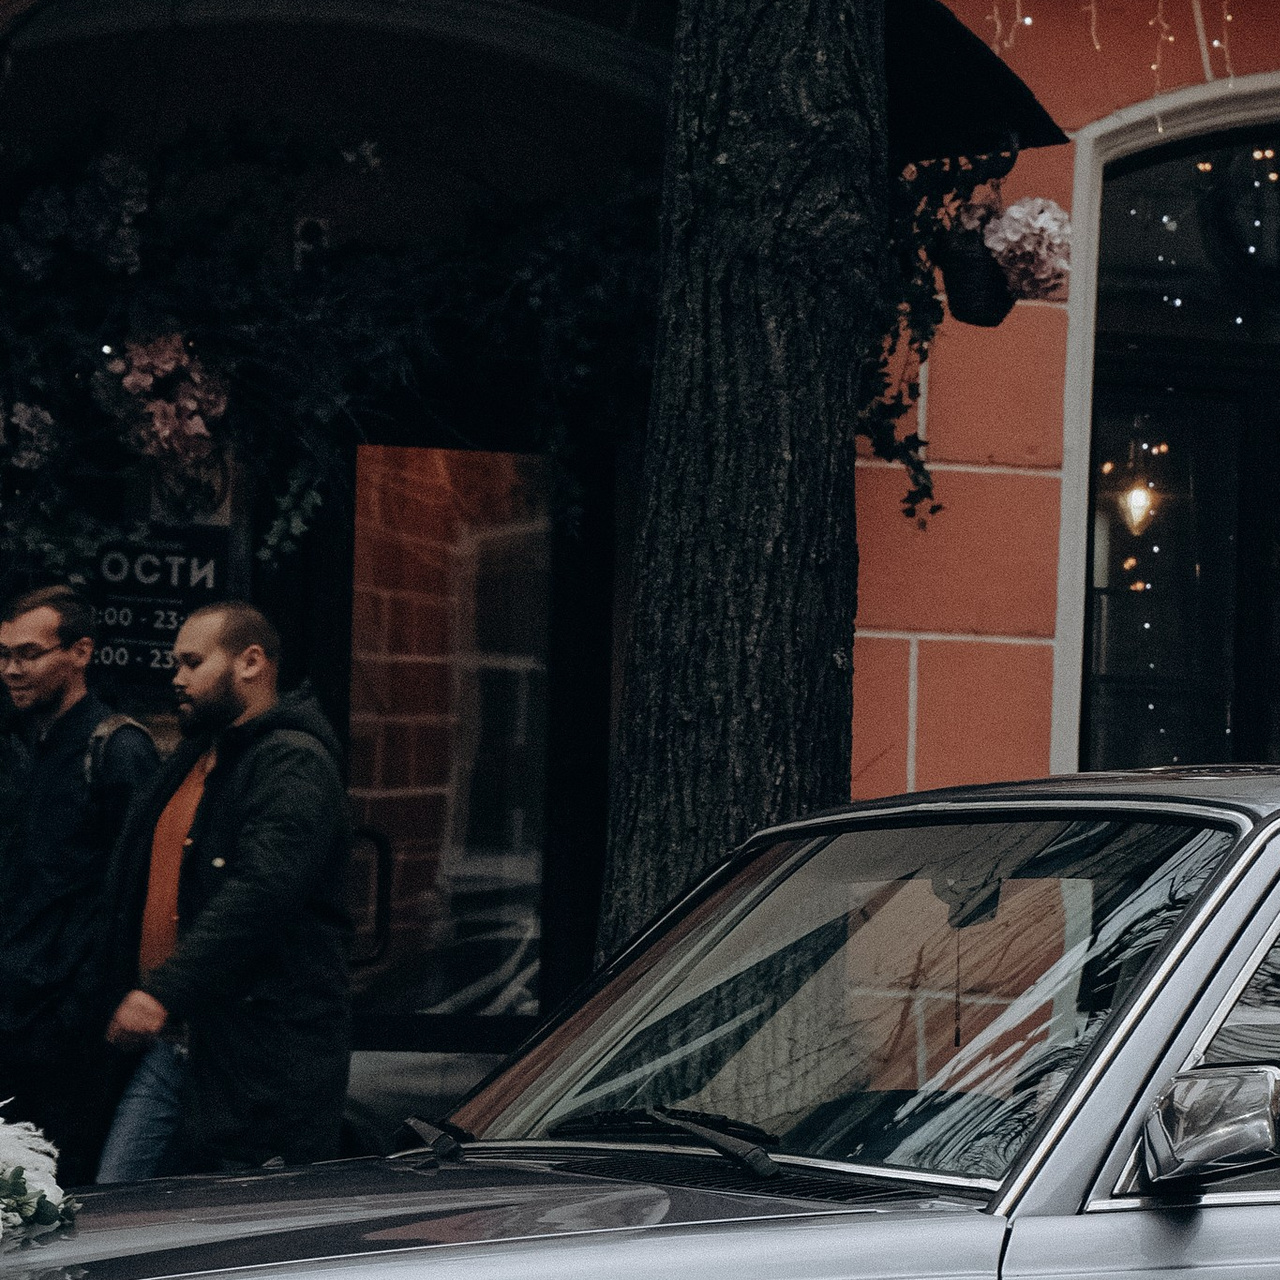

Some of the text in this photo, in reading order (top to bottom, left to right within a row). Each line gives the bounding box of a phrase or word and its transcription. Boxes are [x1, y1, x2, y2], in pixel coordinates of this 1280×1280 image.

[101, 551, 216, 589] ОСТИ
[92, 605, 133, 627] :00
[93, 645, 130, 666] :00
